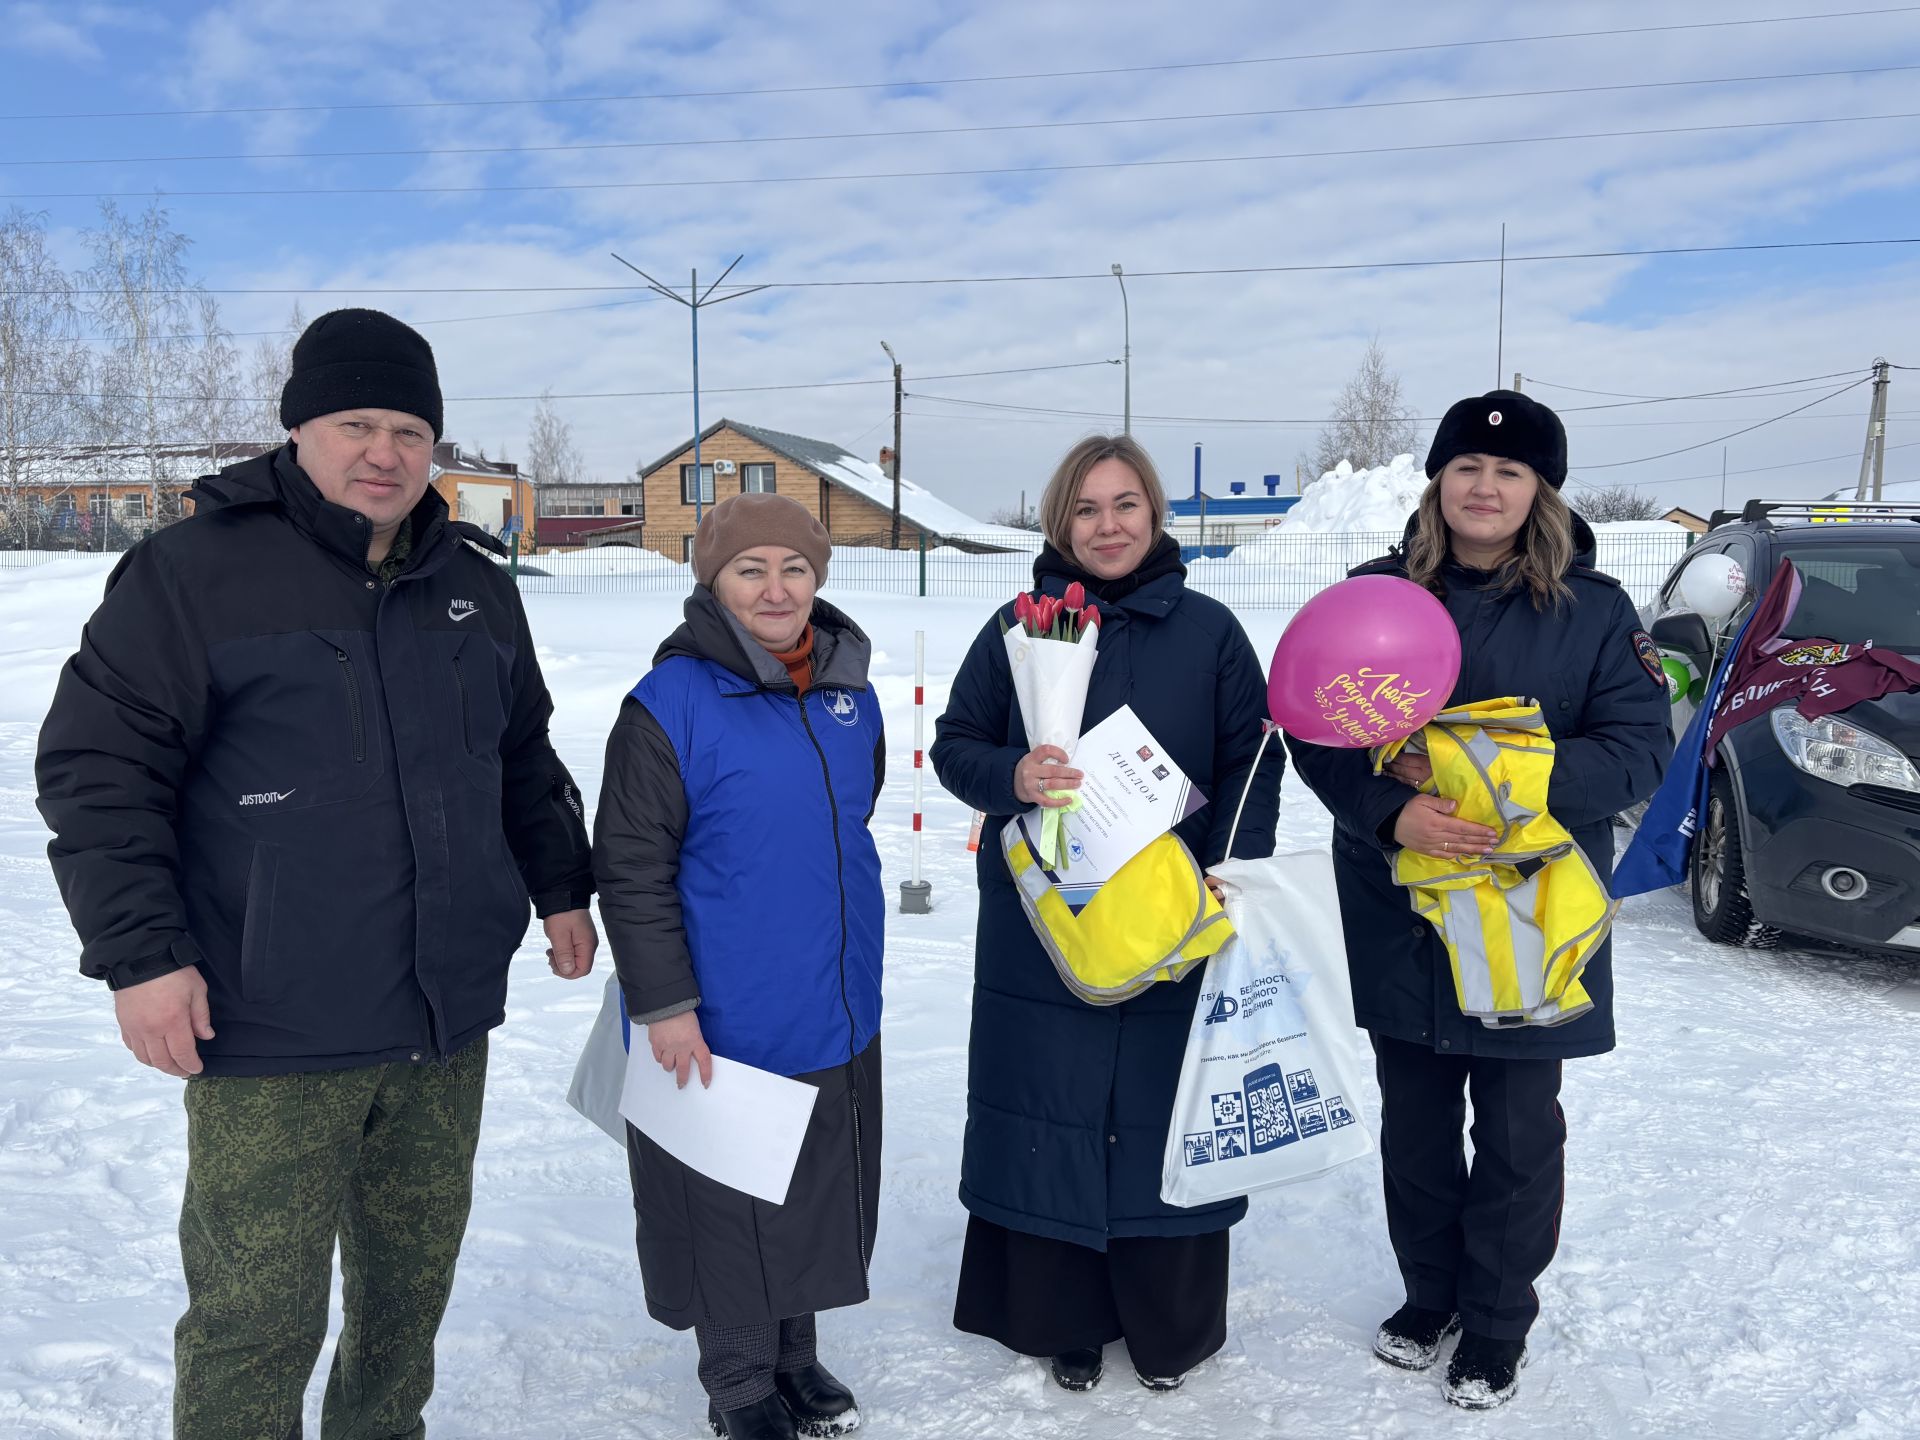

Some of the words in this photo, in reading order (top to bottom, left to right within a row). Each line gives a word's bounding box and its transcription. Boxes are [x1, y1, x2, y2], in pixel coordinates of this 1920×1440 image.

[451, 598, 475, 610] NIKE
[1108, 751, 1158, 803] ДИПЛОМ
[1201, 992, 1217, 1002] ГБУ
